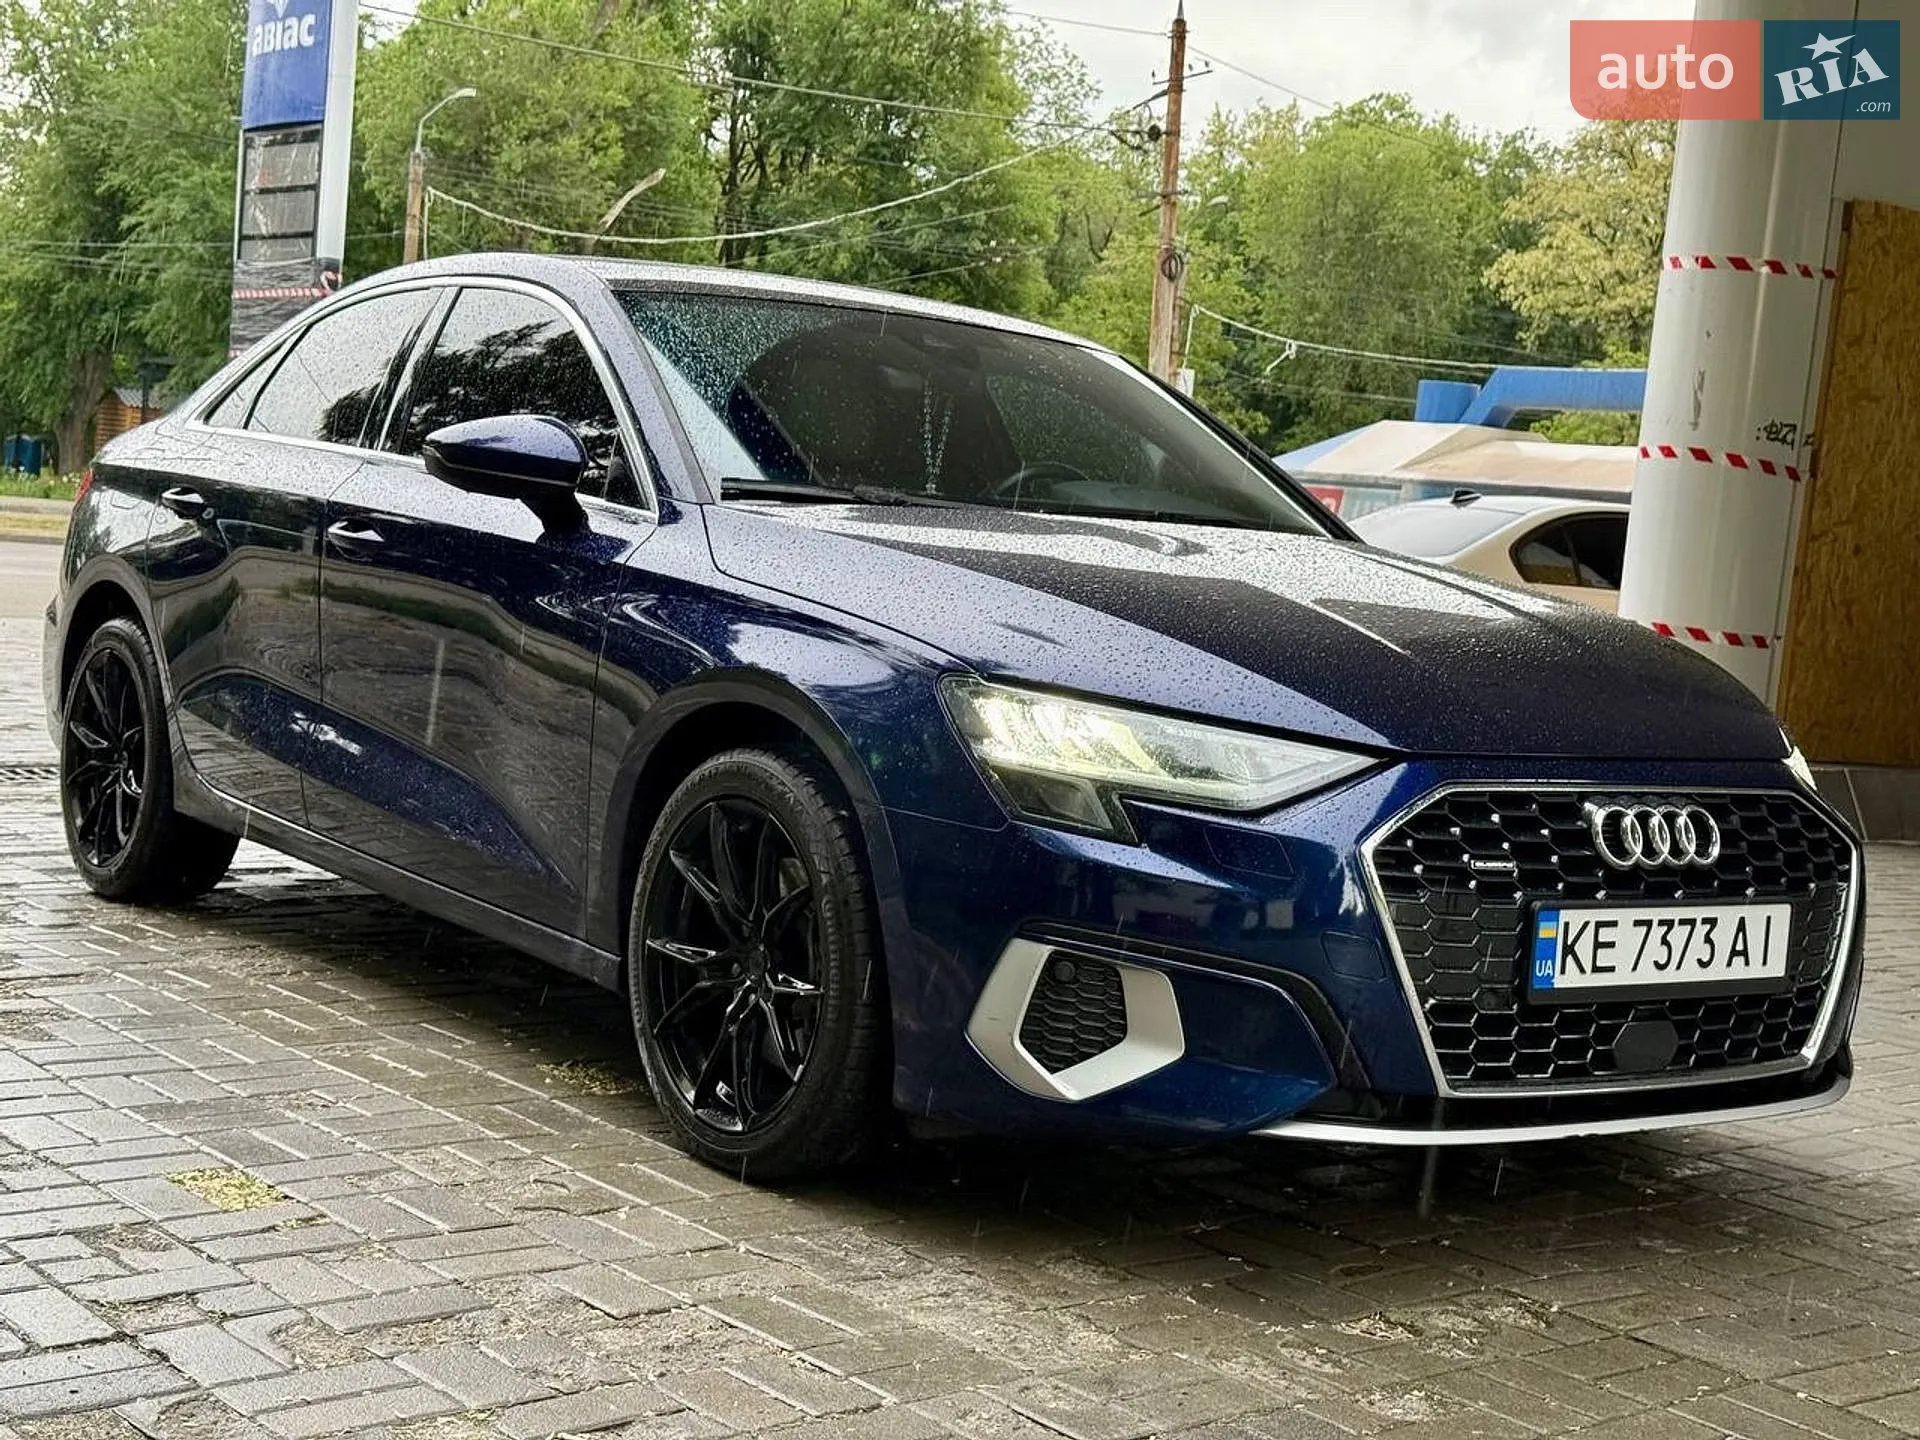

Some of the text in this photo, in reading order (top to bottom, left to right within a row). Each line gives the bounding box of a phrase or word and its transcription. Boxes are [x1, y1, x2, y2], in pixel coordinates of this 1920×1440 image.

[1560, 915, 1771, 975] KE 7373 AI
[1536, 960, 1554, 977] UA
